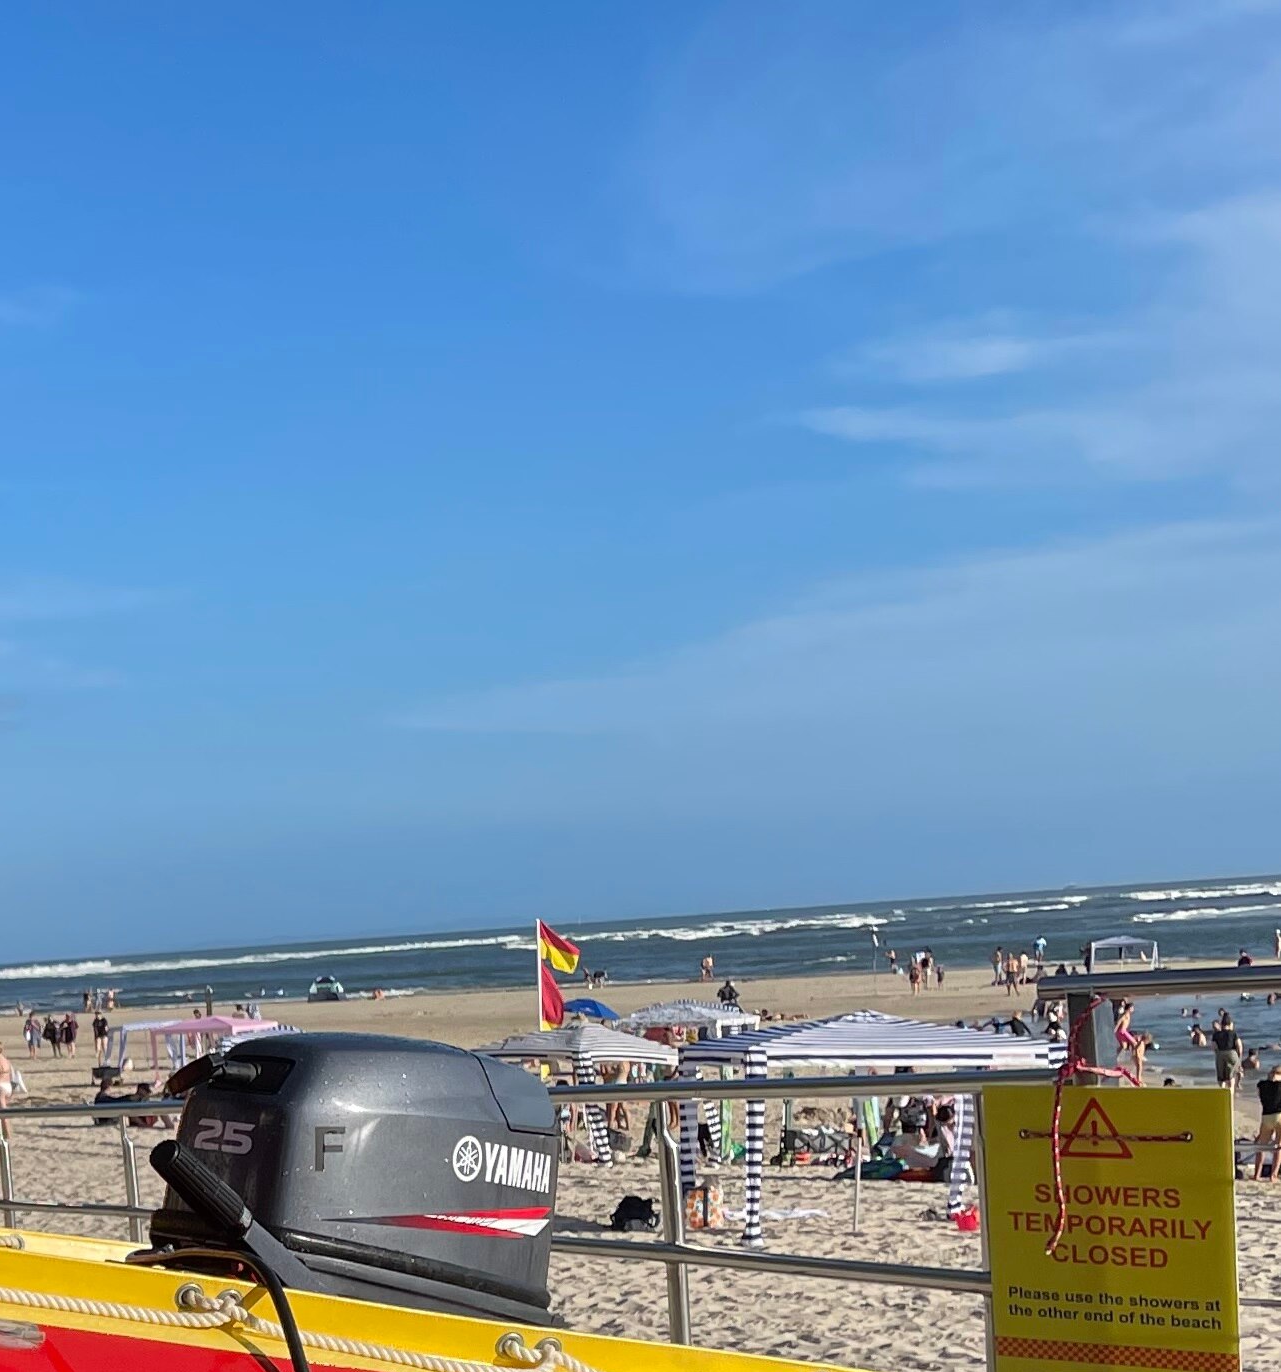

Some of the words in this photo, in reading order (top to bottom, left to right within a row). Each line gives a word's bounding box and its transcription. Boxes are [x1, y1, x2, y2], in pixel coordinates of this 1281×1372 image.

[194, 1117, 256, 1155] 25
[314, 1126, 346, 1172] F
[484, 1141, 552, 1194] YAMAHA
[1050, 1243, 1169, 1269] CLOSED
[1008, 1286, 1060, 1302] Please
[1065, 1292, 1094, 1305] use
[1099, 1292, 1124, 1307] the
[1129, 1294, 1200, 1312] showers
[1204, 1300, 1221, 1312] at
[1008, 1304, 1033, 1317] the
[1037, 1306, 1079, 1321] other
[1083, 1308, 1114, 1324] end
[1118, 1311, 1136, 1325] of
[1140, 1313, 1166, 1328] the
[1171, 1315, 1222, 1331] beach
